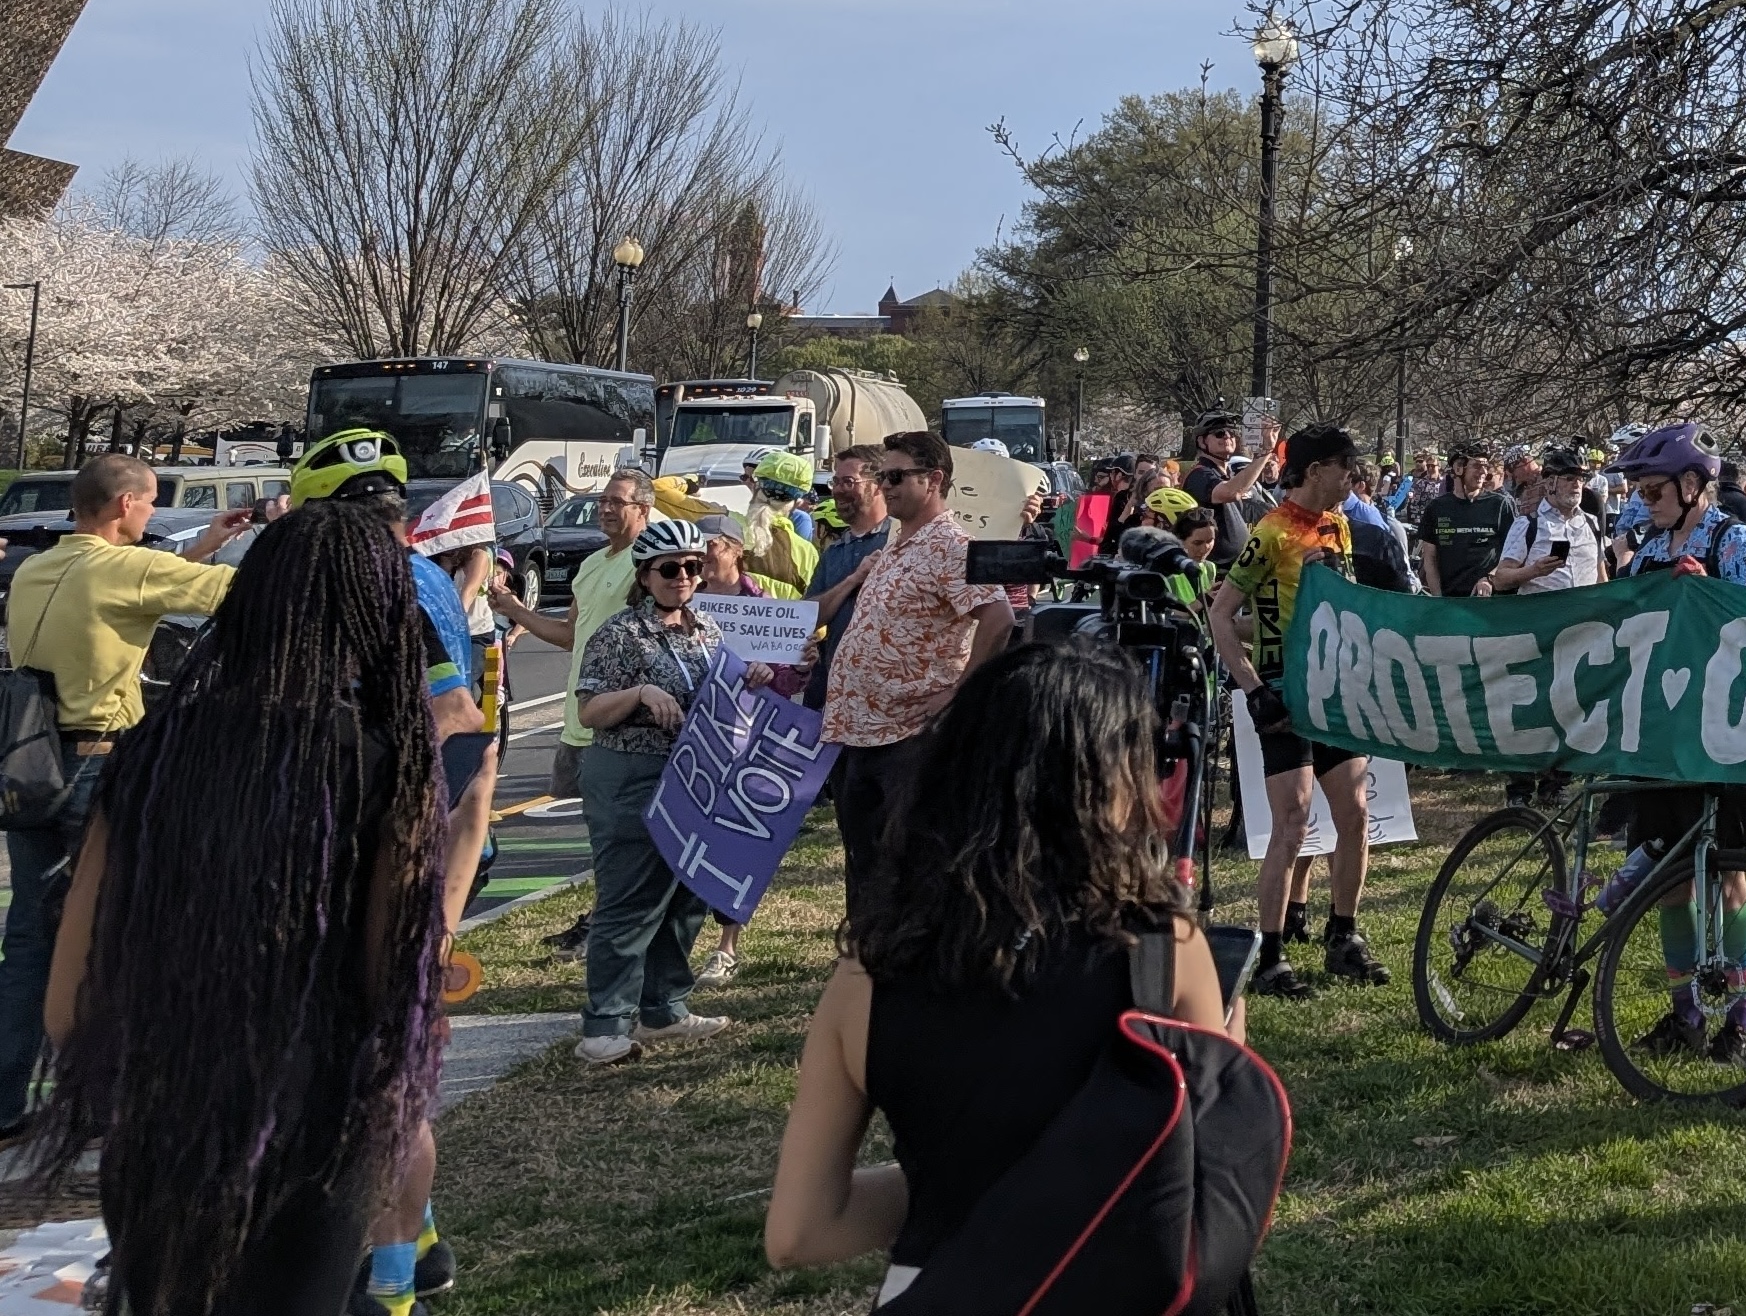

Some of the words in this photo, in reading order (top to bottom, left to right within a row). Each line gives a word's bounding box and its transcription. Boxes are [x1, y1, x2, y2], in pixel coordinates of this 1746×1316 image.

[432, 361, 449, 370] 147
[577, 451, 611, 478] Executive
[699, 601, 739, 615] BIKERS
[741, 604, 773, 618] SAVE
[775, 606, 800, 620] OIL.
[717, 620, 736, 633] NES
[739, 624, 770, 637] SAVE
[1307, 601, 1670, 755] PROTECT
[672, 651, 766, 816] BIKE
[713, 707, 824, 840] VOTE
[648, 780, 699, 869] I
[686, 840, 753, 910] I
